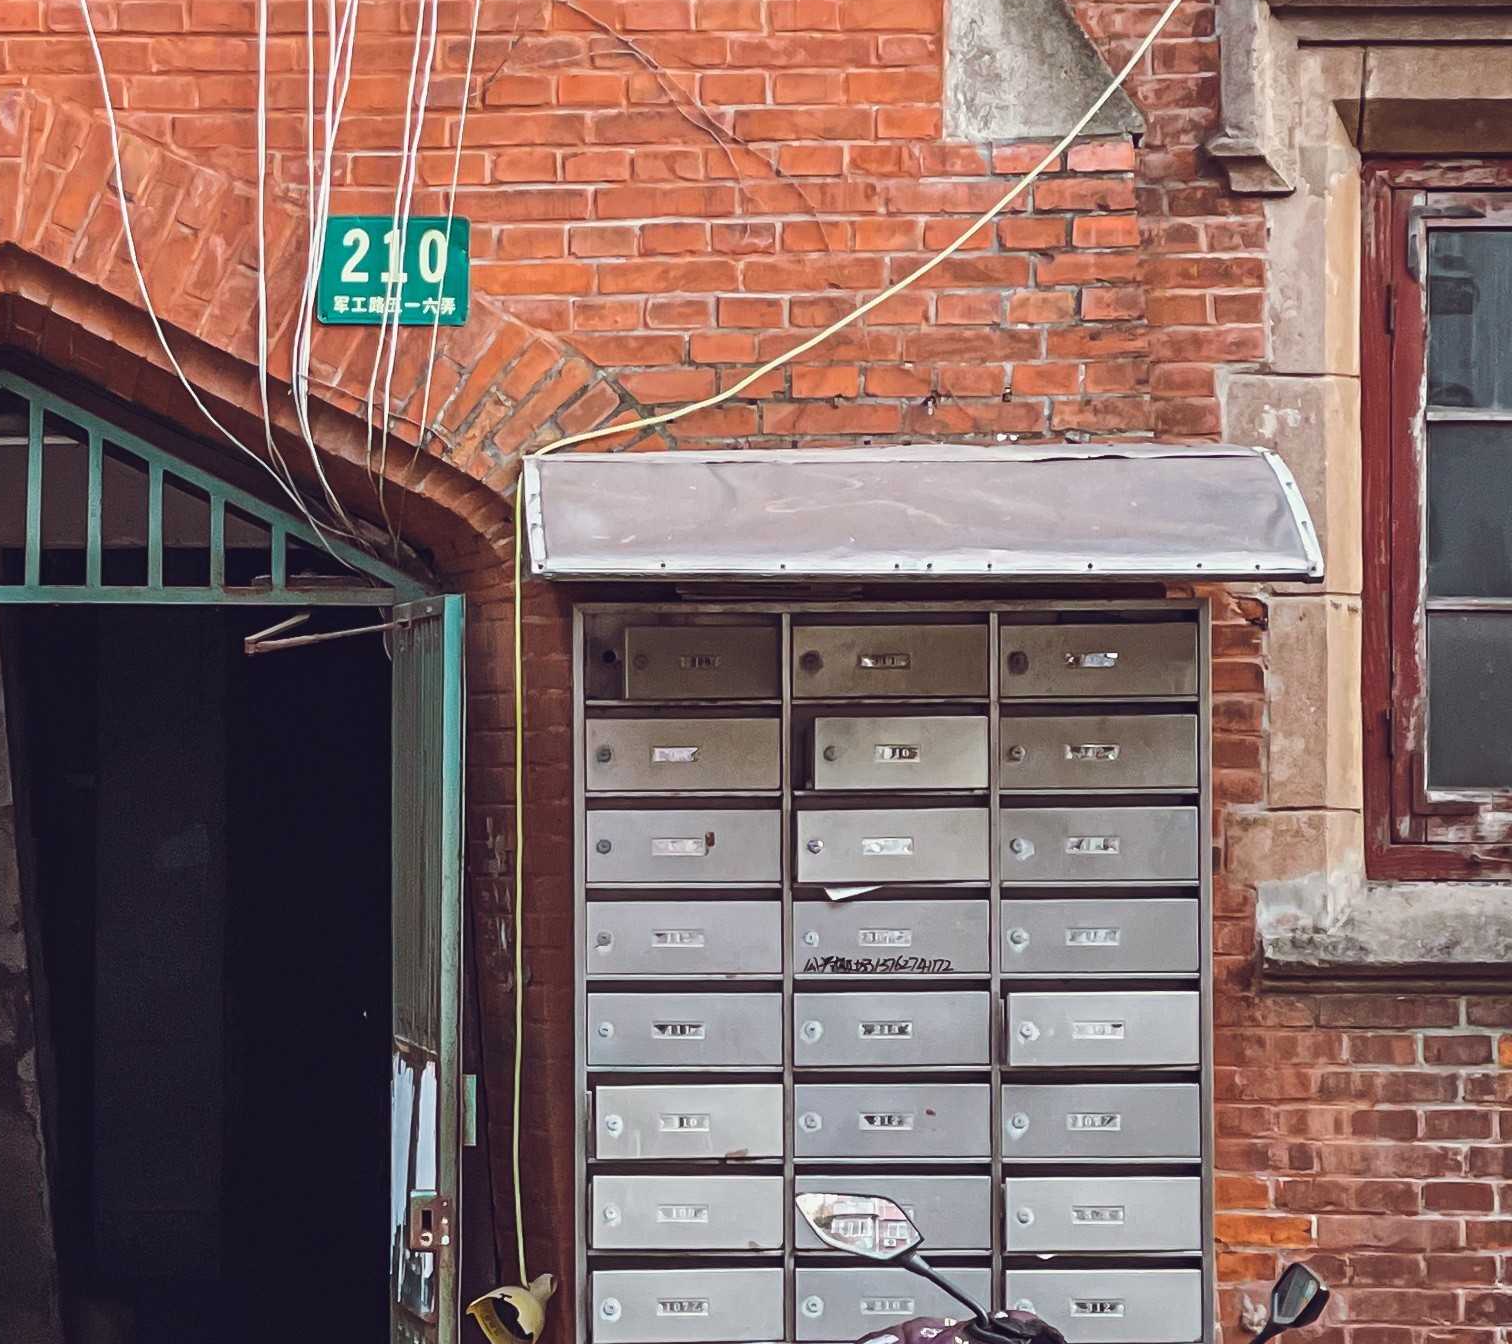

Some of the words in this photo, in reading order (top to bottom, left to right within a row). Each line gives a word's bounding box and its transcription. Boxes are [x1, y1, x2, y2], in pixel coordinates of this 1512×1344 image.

[341, 228, 447, 283] 210
[333, 295, 457, 315] 军工路五一六弄
